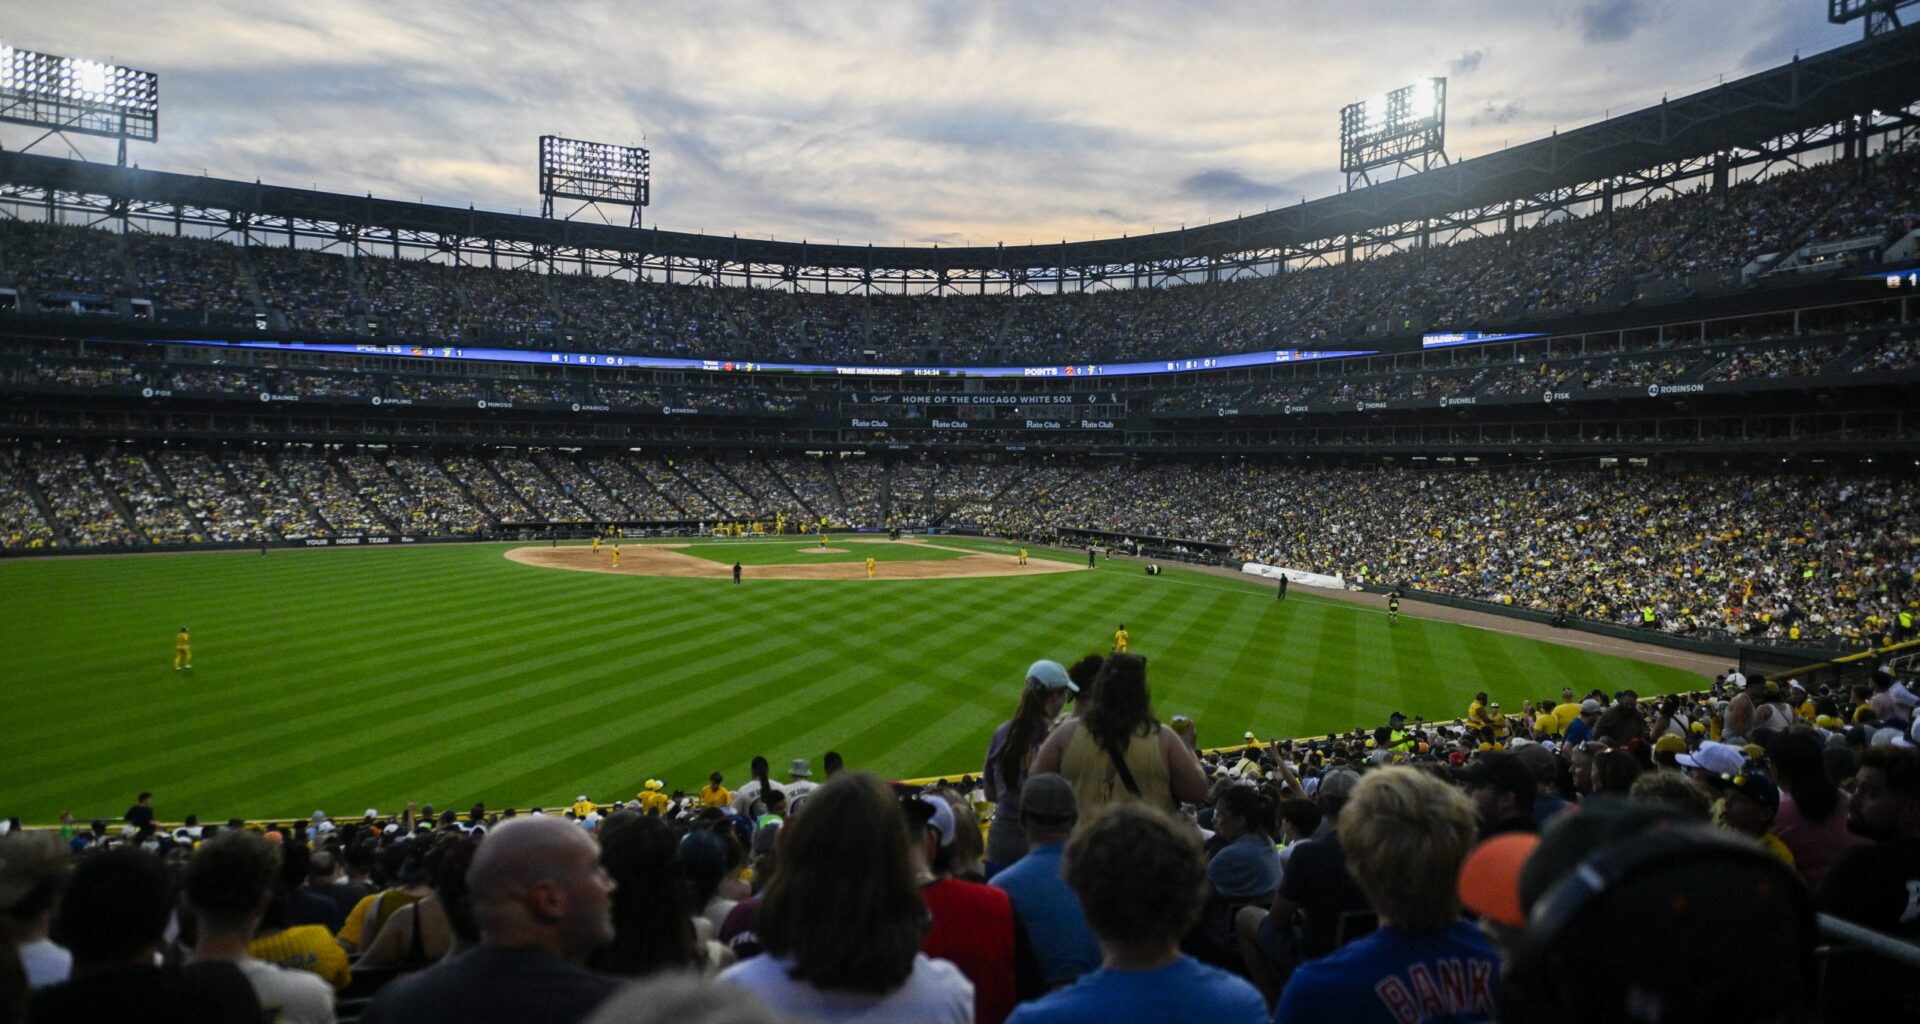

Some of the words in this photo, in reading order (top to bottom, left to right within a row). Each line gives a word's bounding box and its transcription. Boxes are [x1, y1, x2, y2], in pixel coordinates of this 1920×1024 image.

[836, 367, 856, 375] TIME
[1024, 367, 1058, 376] POINTS
[1660, 384, 1704, 394] ROBINSON
[902, 396, 931, 404] HOME
[934, 396, 948, 404] OF
[950, 396, 969, 404] THE
[972, 396, 1017, 404] CHICAGO
[1448, 397, 1477, 405] BUEHRLE
[852, 419, 871, 427] Rate
[932, 420, 950, 428] Rate
[1026, 420, 1043, 429] Rate
[1082, 420, 1098, 428] Rate
